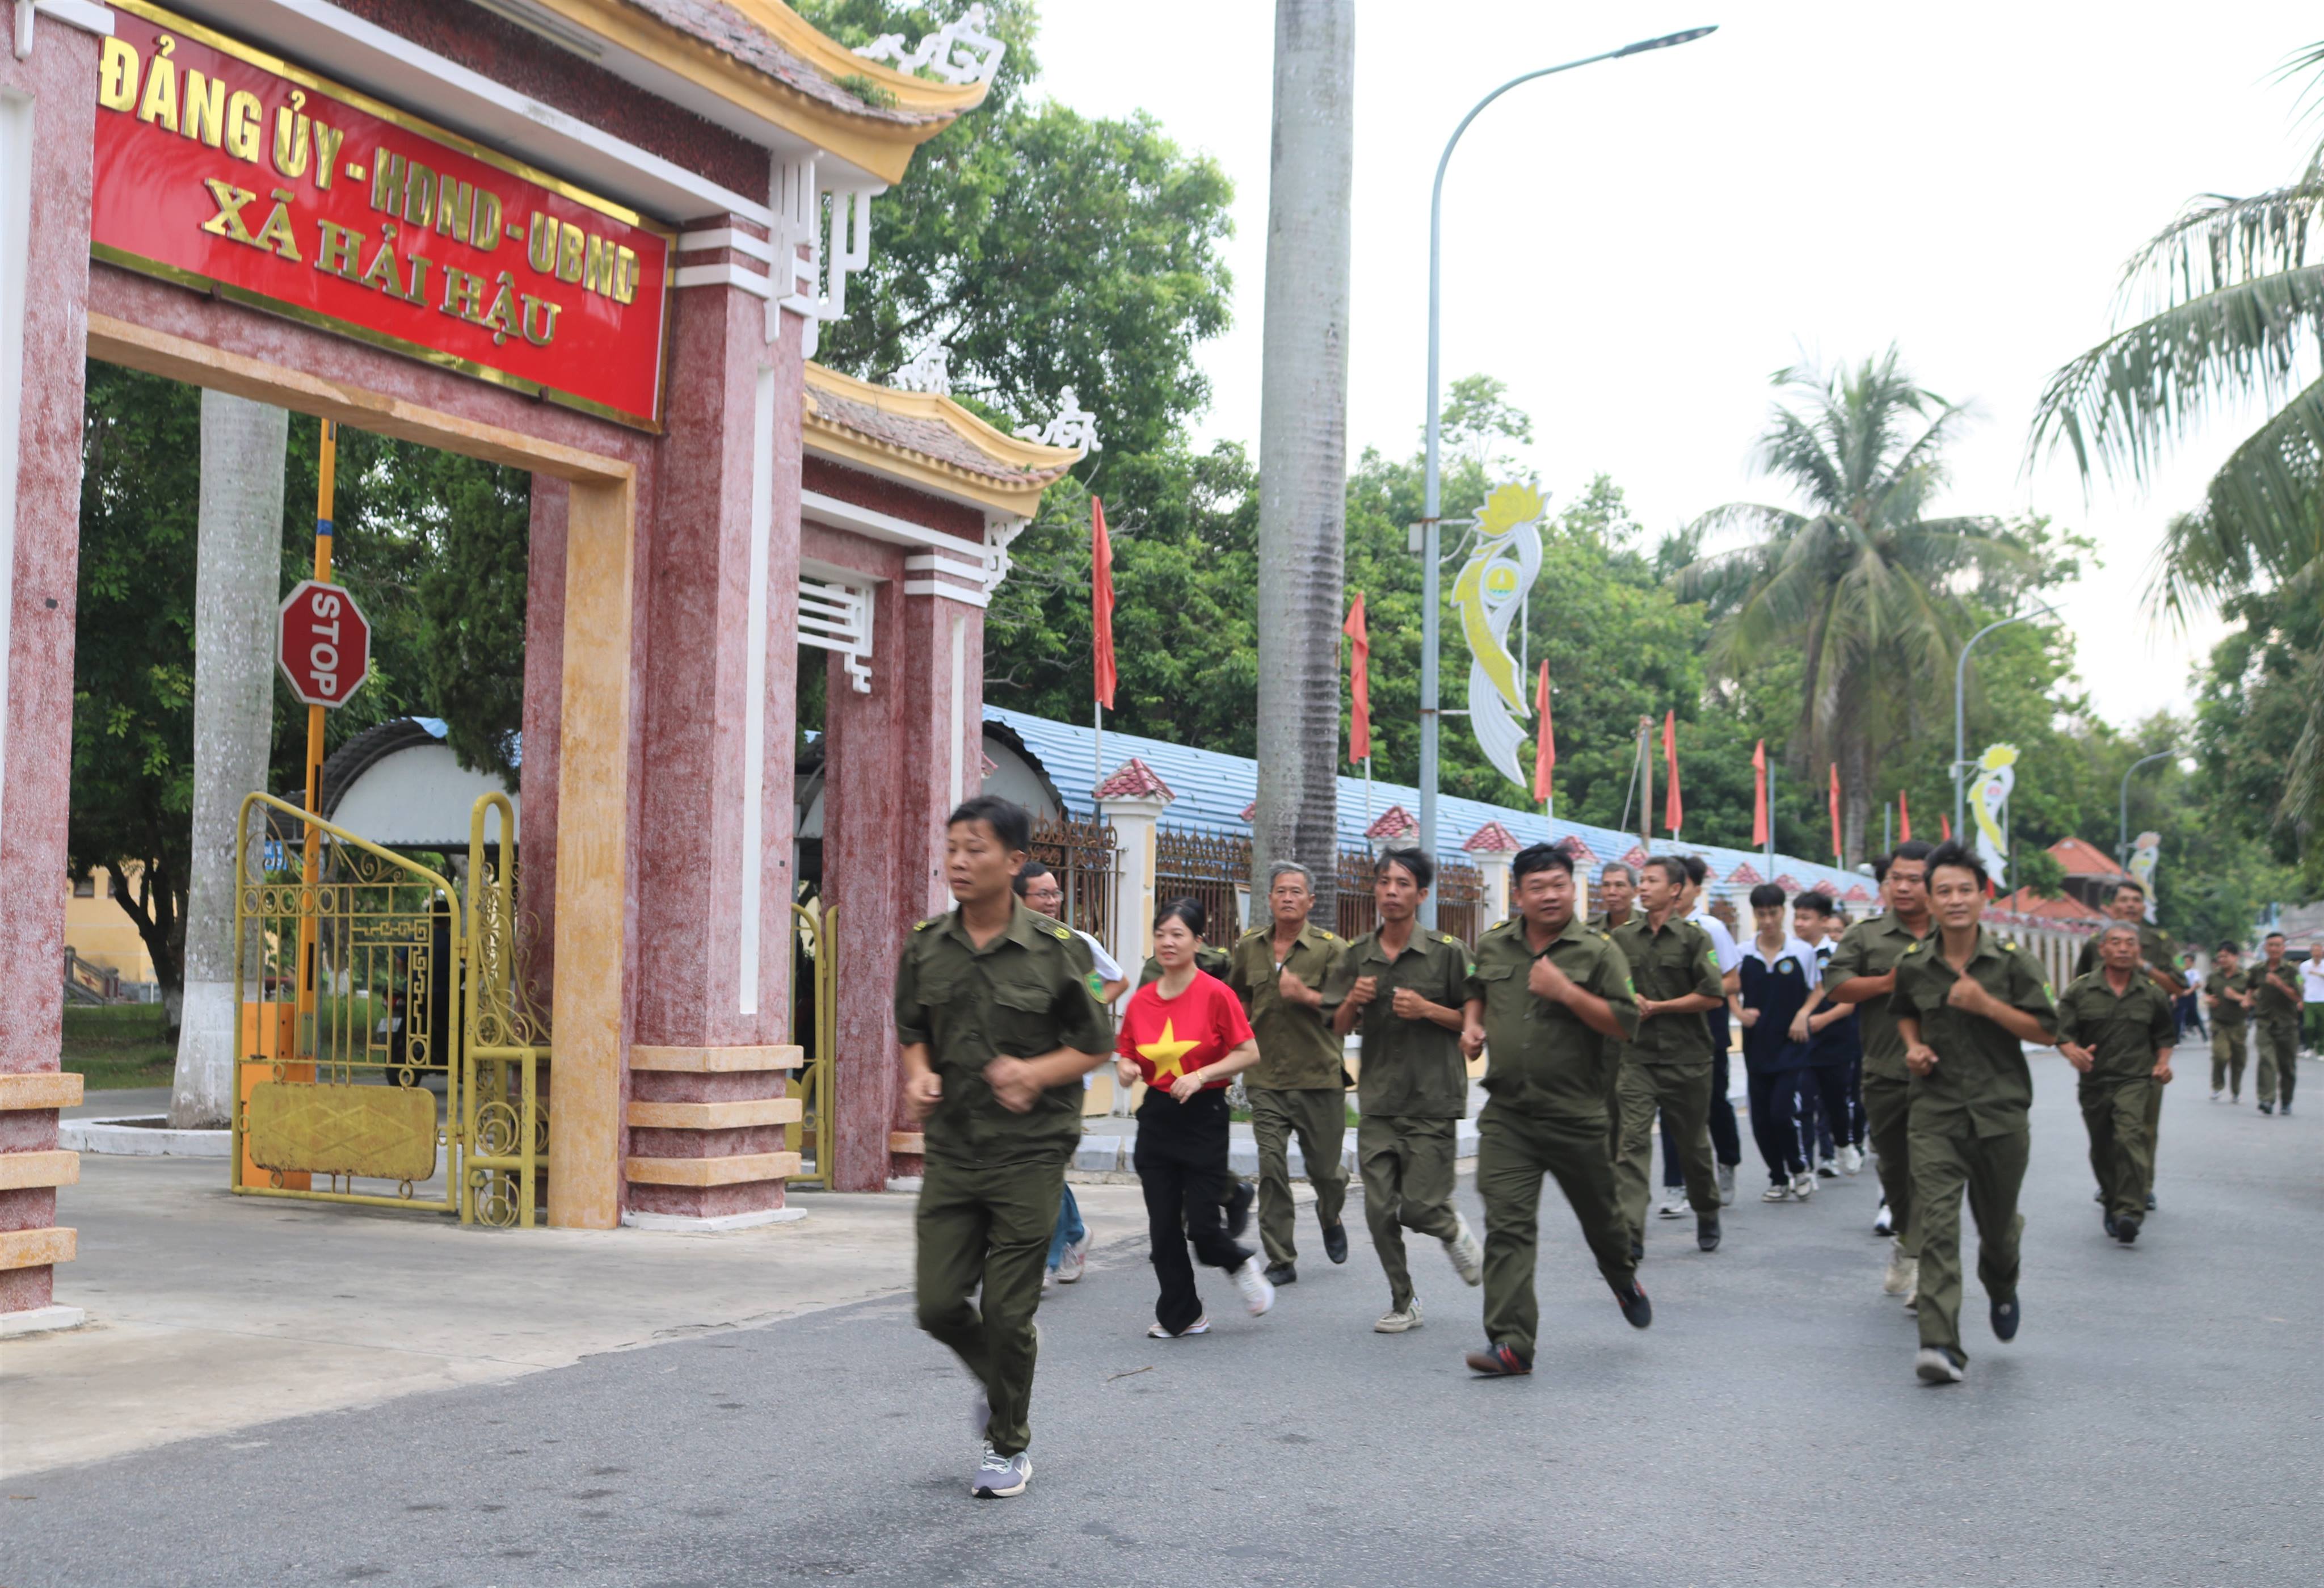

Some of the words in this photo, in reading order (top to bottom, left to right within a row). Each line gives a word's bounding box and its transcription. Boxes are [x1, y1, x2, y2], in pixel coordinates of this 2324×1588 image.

[97, 34, 263, 164] ĐẢNG
[201, 178, 302, 262] XÃ
[314, 219, 432, 306] HẢI
[439, 271, 562, 346] HẬU
[310, 593, 340, 697] STOP
